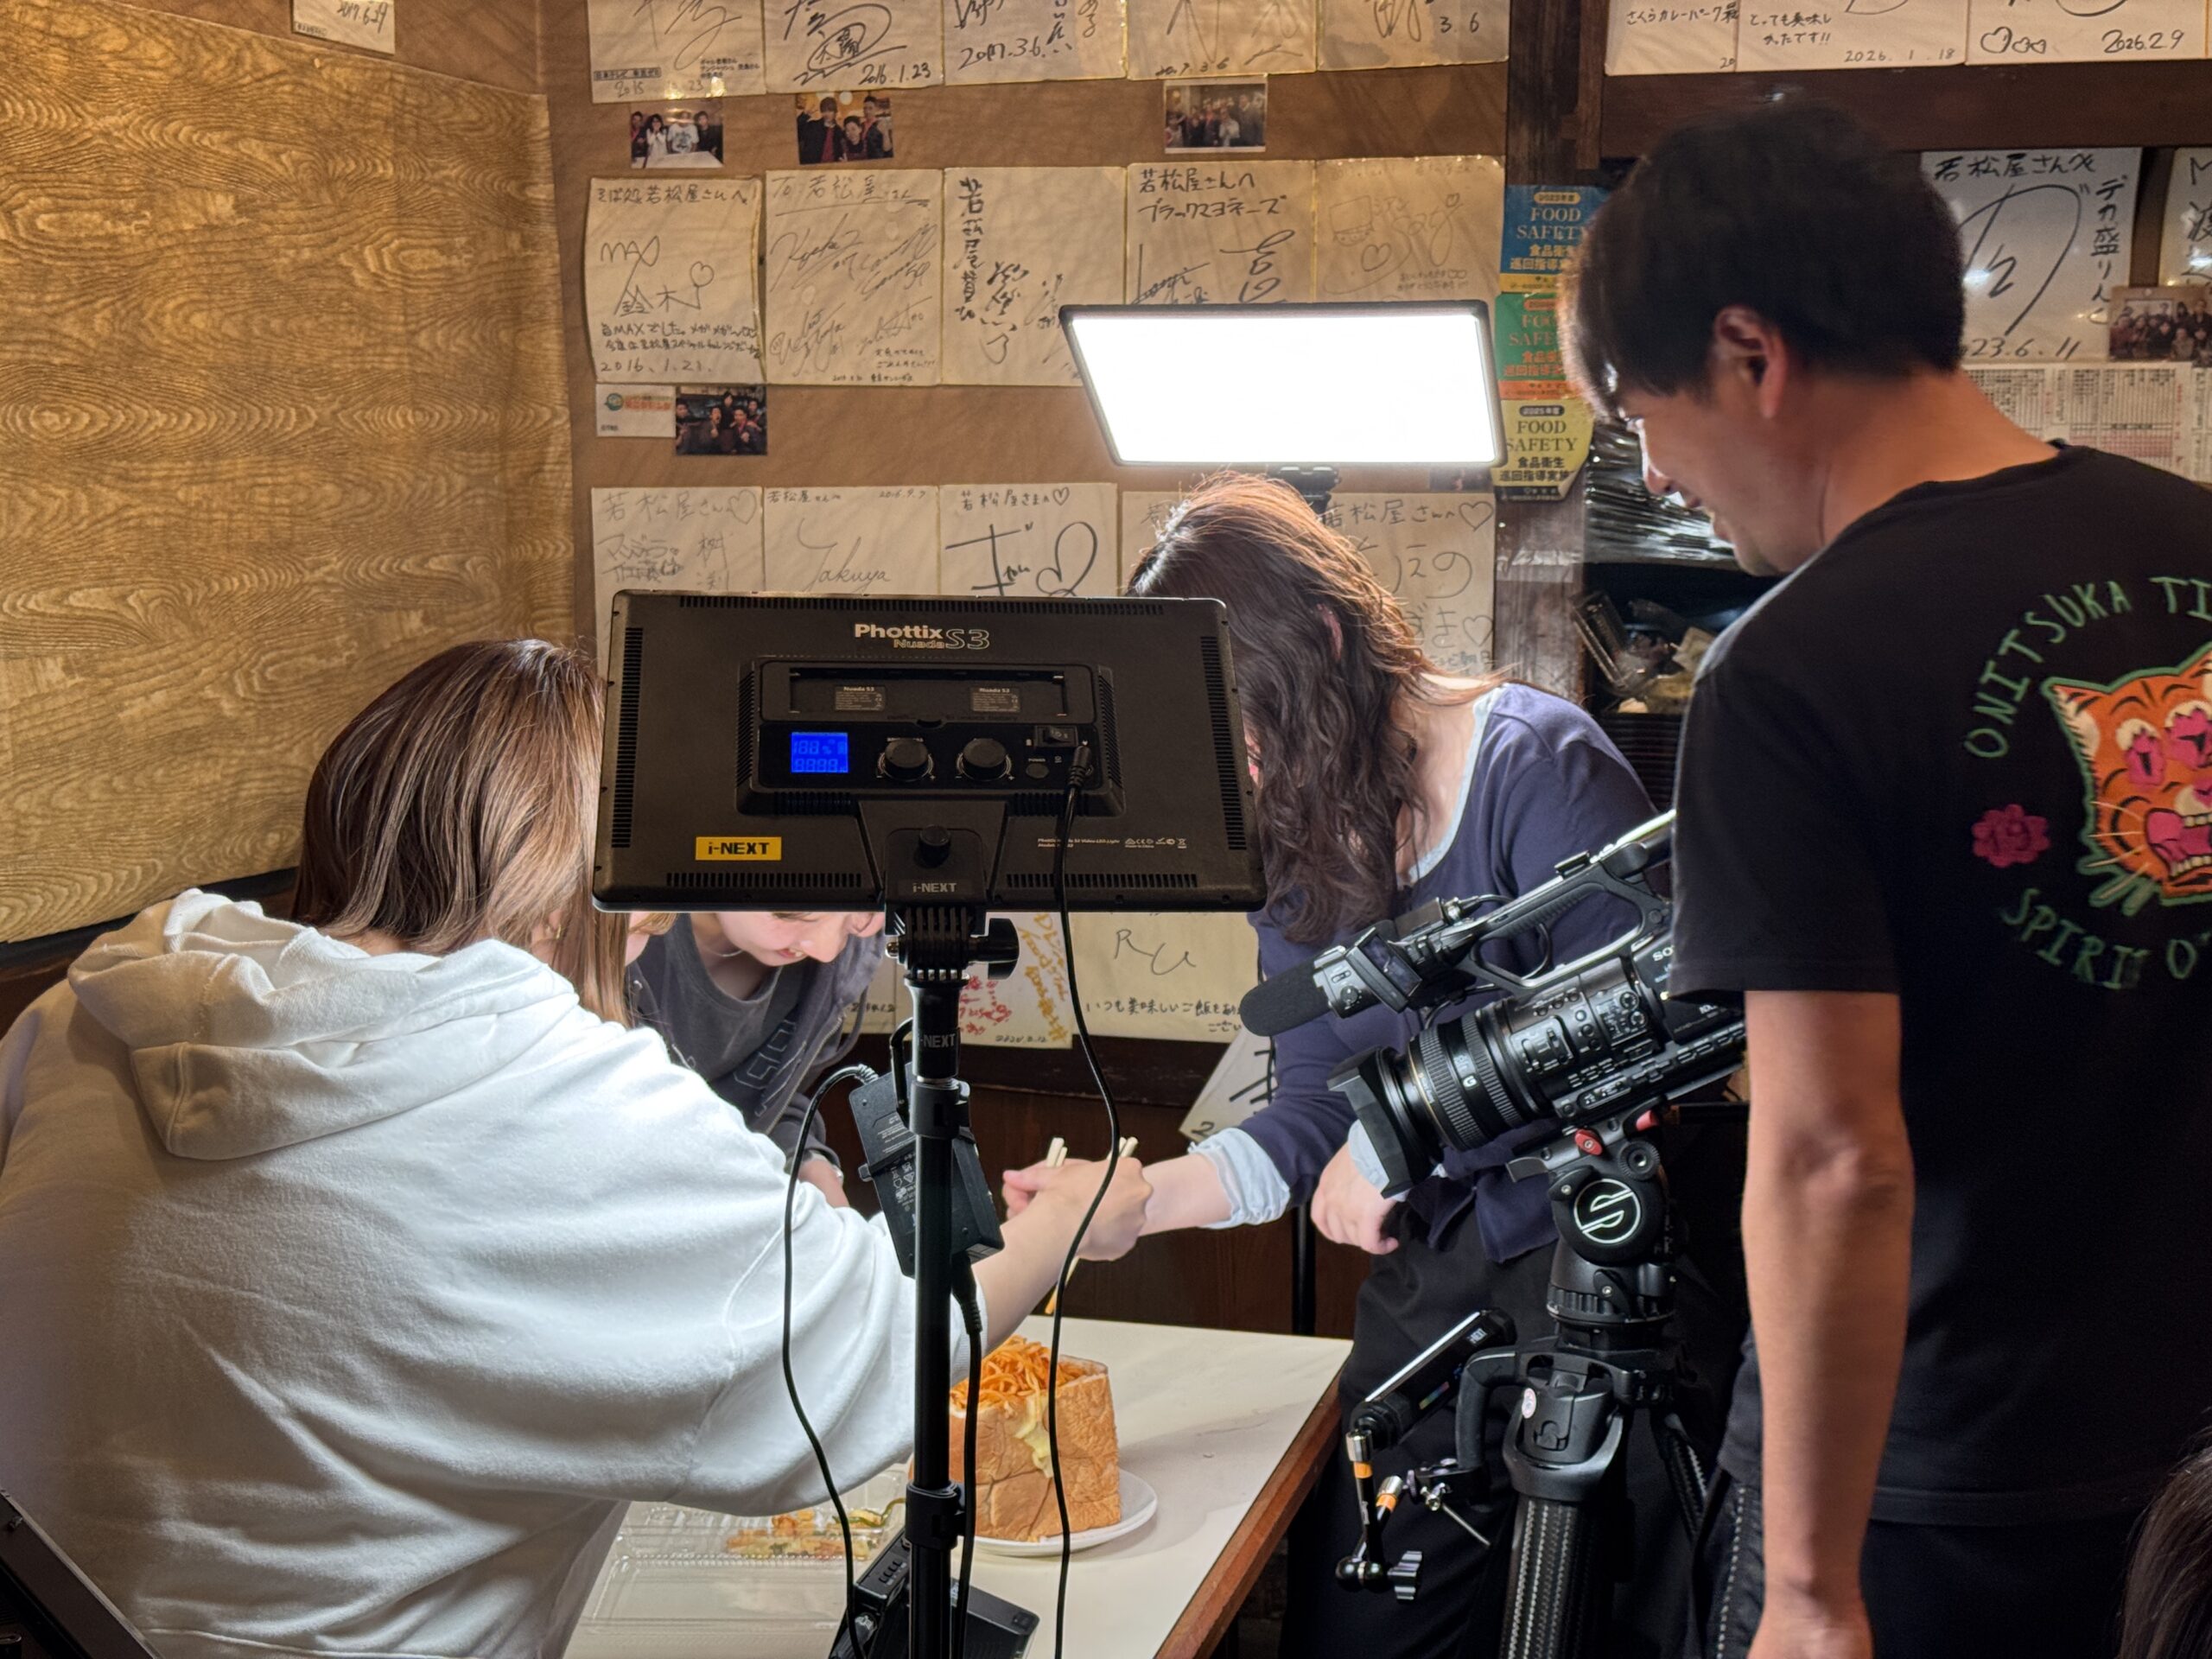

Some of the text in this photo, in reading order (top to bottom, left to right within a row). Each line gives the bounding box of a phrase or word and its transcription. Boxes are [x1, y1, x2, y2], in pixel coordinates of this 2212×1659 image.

[1140, 168, 1255, 194] 若松屋さんへ
[1138, 195, 1287, 223] ブラックマヨネーズ
[1530, 207, 1581, 222] FOOD
[1517, 420, 1567, 435] FOOD
[1506, 437, 1579, 452] SAFETY
[855, 624, 944, 639] Phottix
[893, 629, 990, 650] Nuada S3
[1963, 580, 2133, 759] ONITSUKA
[708, 842, 770, 855] i-NEXT
[912, 882, 957, 893] i-NEXT
[1085, 997, 1242, 1016] いつも美味しいご飯をあり
